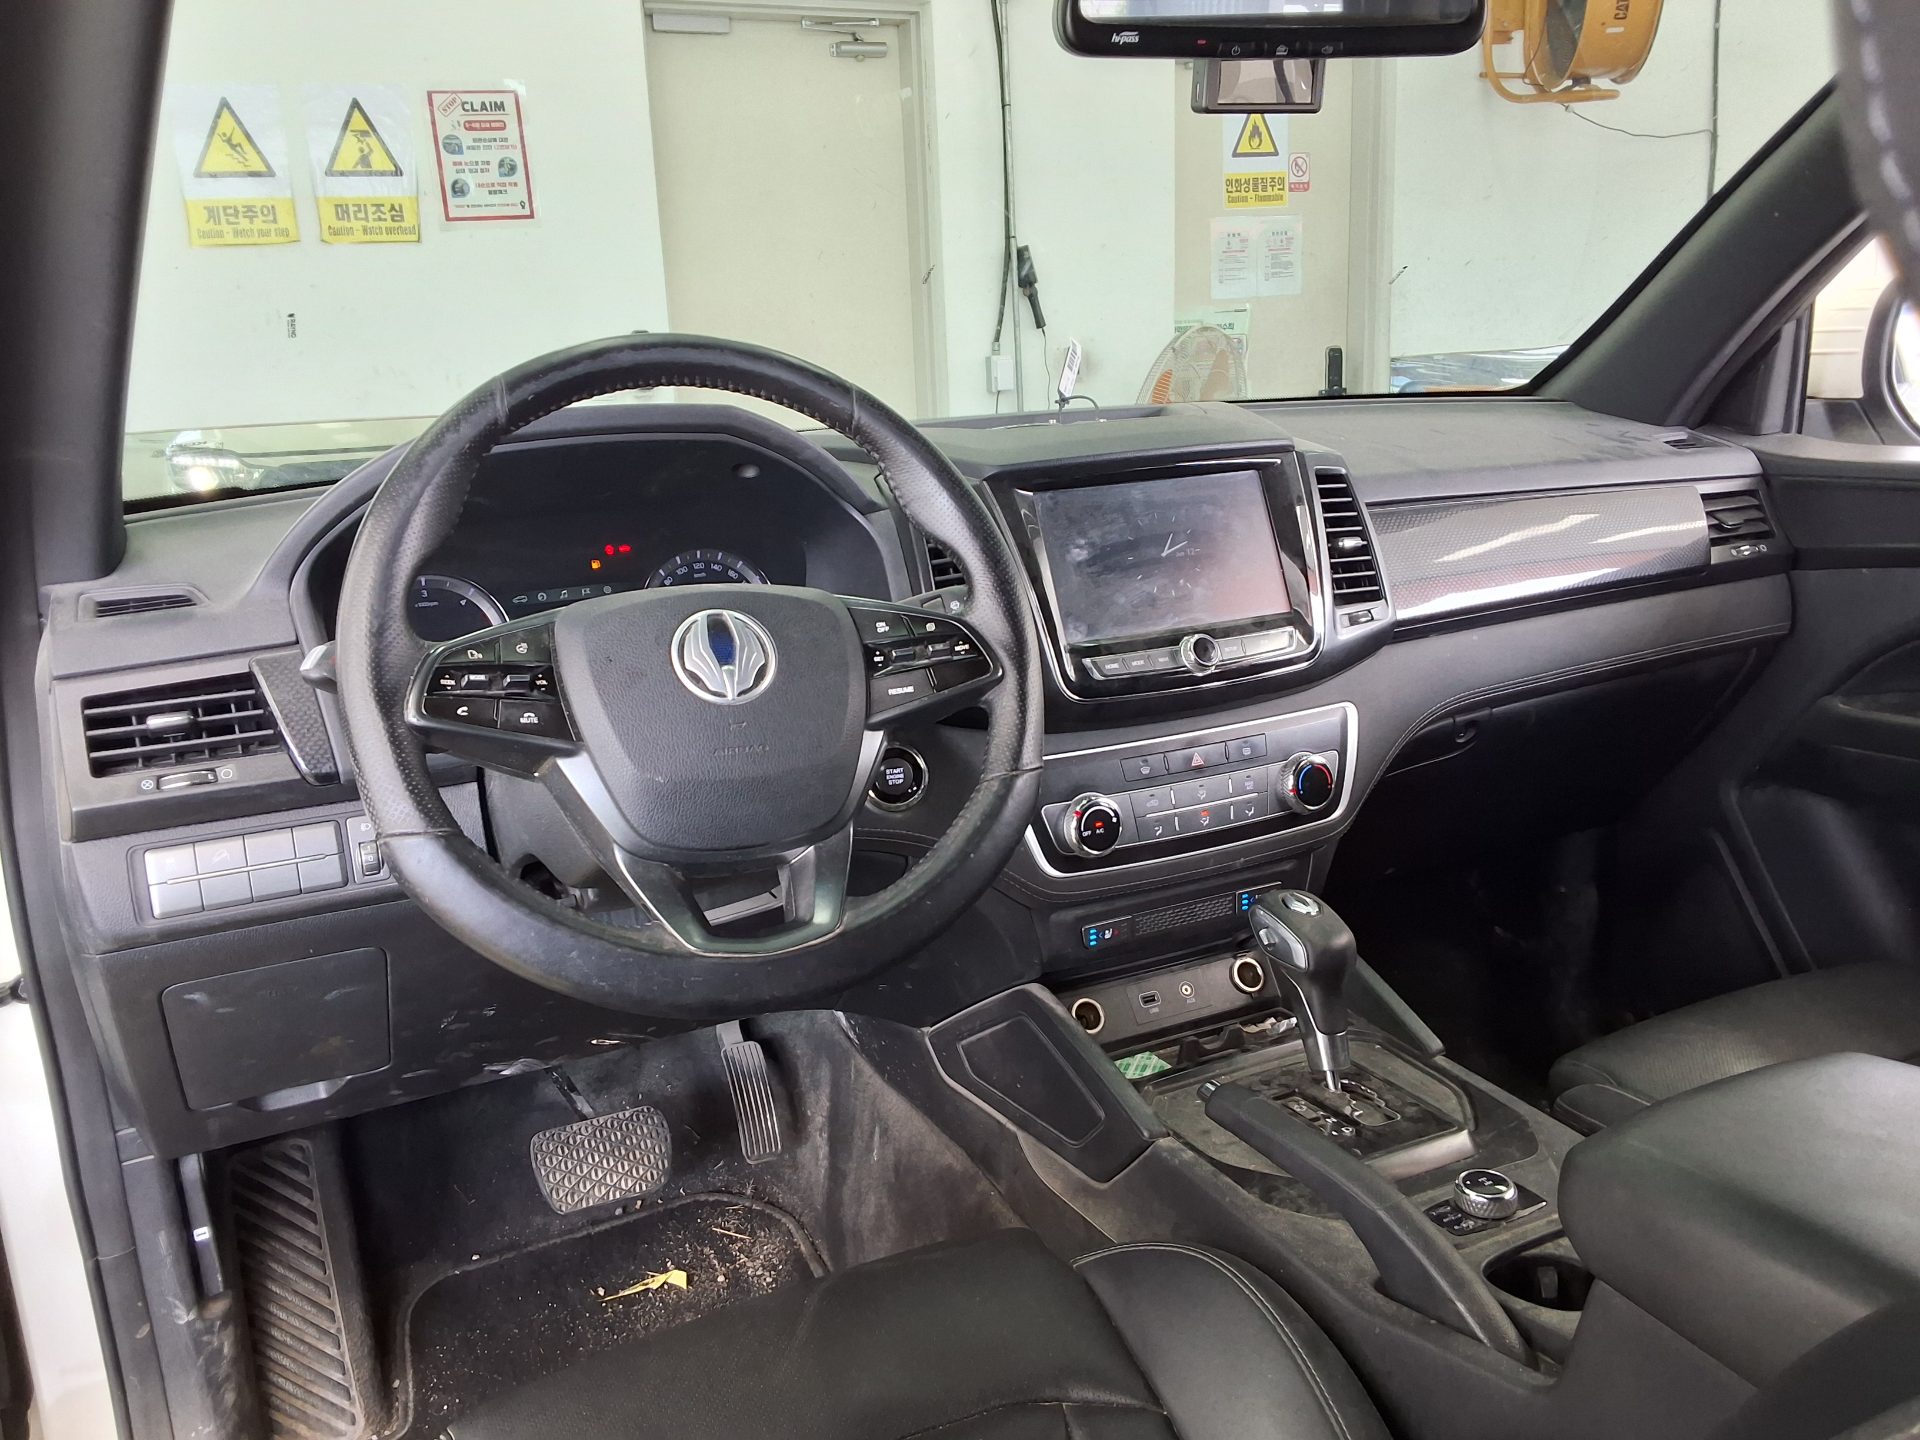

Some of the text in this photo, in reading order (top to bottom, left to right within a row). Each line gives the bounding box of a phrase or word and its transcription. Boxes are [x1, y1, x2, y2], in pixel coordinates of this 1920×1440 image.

[441, 96, 458, 114] STOP
[461, 101, 506, 112] CLAIM
[1225, 177, 1285, 193] 인화성물질주의
[1227, 195, 1248, 203] Caution
[1254, 193, 1284, 202] Flammable
[203, 204, 278, 225] 계단주의
[335, 203, 405, 223] 머리조심
[197, 229, 224, 239] Caution
[233, 228, 255, 239] Watch
[256, 229, 272, 239] your
[274, 227, 289, 238] step
[328, 225, 354, 236] Caution
[362, 226, 383, 236] Watch
[384, 224, 417, 236] overhead
[676, 565, 689, 575] 100
[710, 563, 723, 572] 140
[888, 685, 914, 695] RESUME
[885, 767, 904, 775] START
[888, 778, 904, 786] STOP
